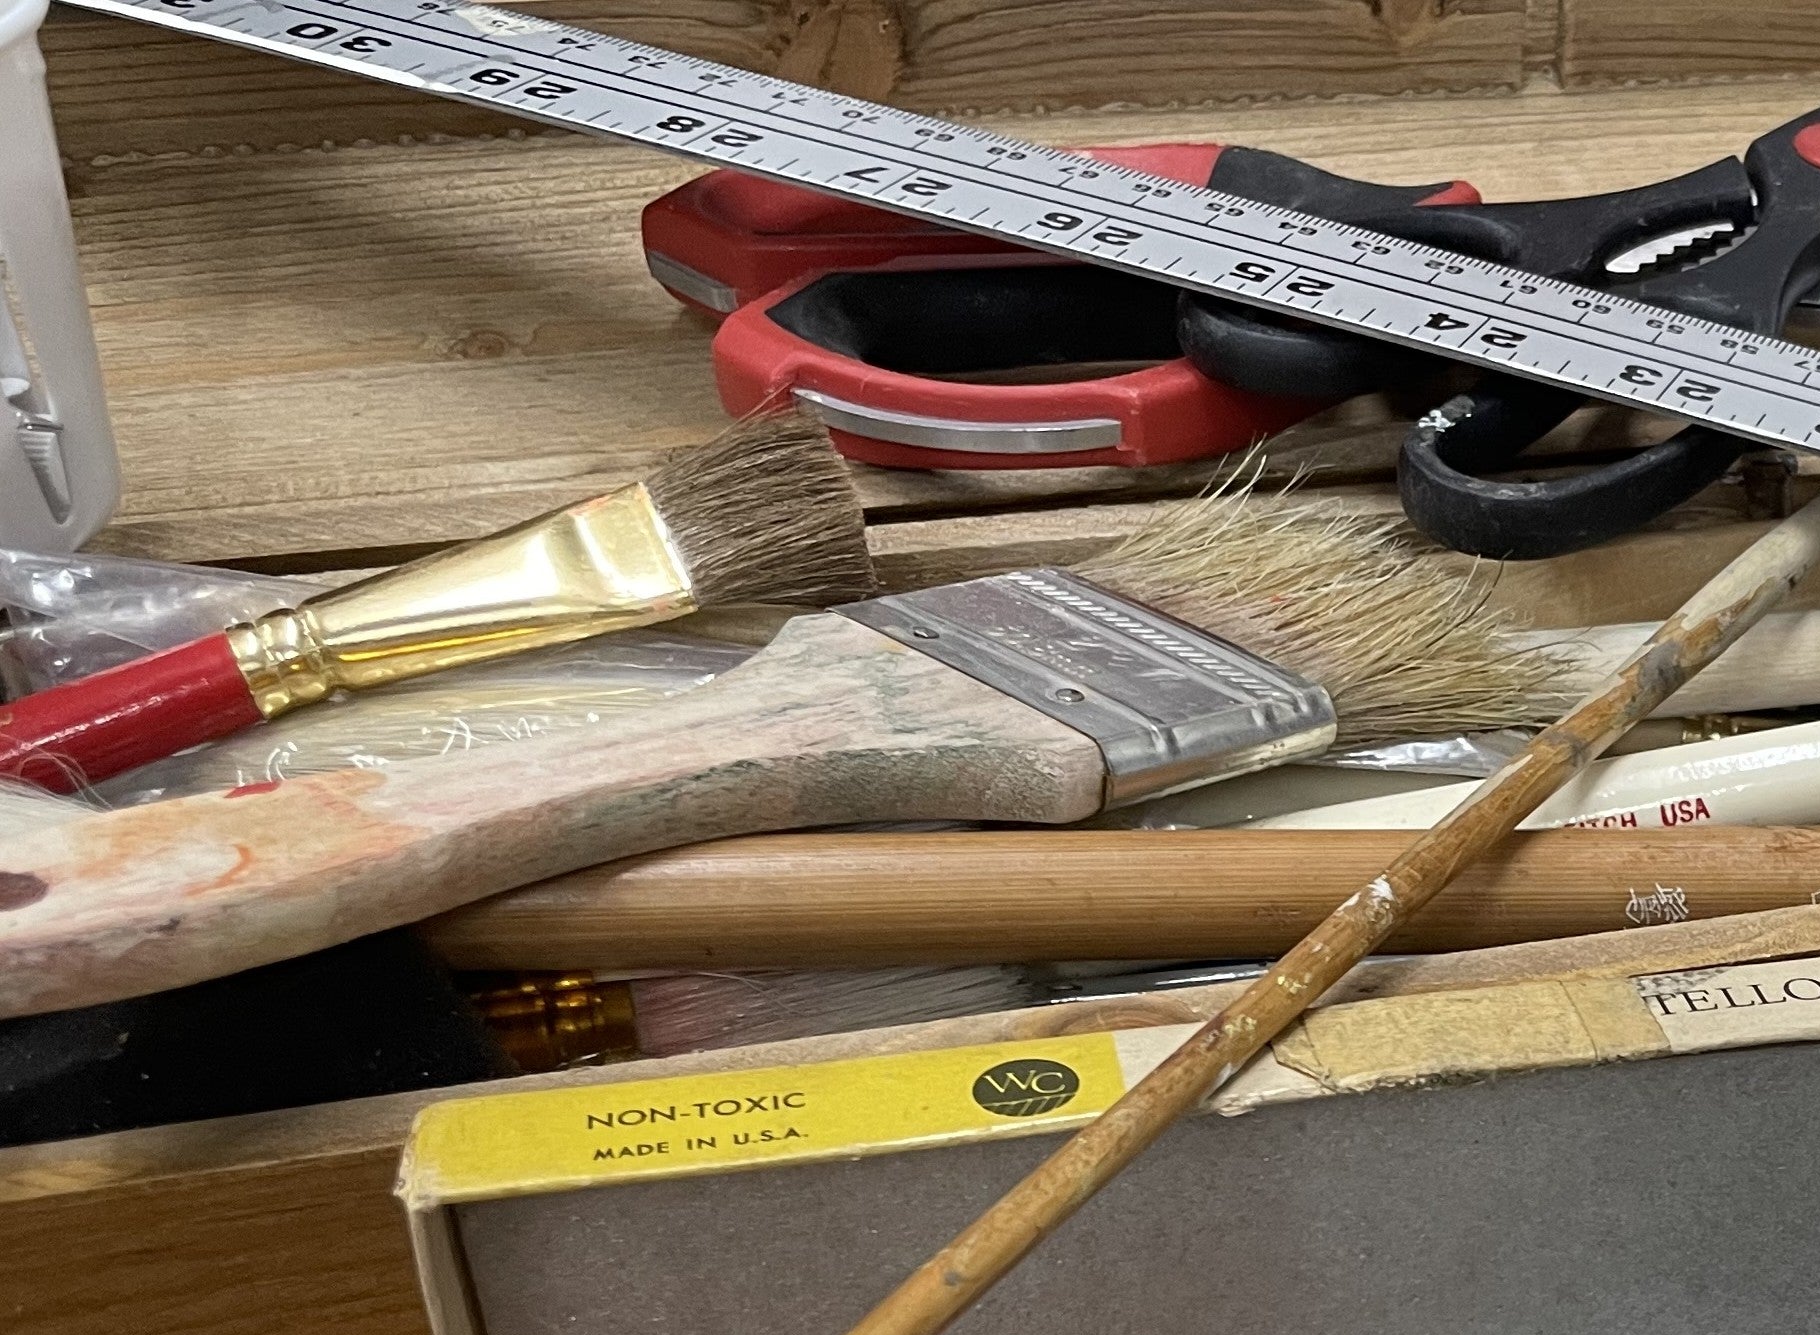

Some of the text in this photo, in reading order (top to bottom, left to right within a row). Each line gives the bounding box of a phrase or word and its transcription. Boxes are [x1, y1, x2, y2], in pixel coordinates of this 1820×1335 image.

[284, 13, 392, 61] 30
[469, 59, 577, 107] 29
[841, 106, 880, 125] 70
[653, 108, 762, 156] 28
[915, 124, 953, 144] 69
[986, 142, 1026, 163] 68
[843, 154, 952, 202] 27
[1059, 161, 1098, 181] 67
[1132, 179, 1171, 199] 66
[1204, 199, 1244, 219] 65
[1036, 204, 1142, 251] 26
[1277, 217, 1317, 237] 64
[1350, 237, 1390, 257] 63
[1422, 256, 1464, 276] 62
[1227, 255, 1333, 303] 25
[1498, 276, 1537, 295] 61
[1572, 296, 1611, 315] 60
[1424, 307, 1525, 352] 24
[1645, 317, 1684, 336] 59
[1718, 336, 1758, 355] 58
[1618, 360, 1720, 405] 23
[1659, 796, 1711, 827] USA
[981, 1070, 1066, 1095] WC
[587, 1092, 807, 1130] NON-TOXIC
[594, 1127, 810, 1161] MADE IN U.S.A.
